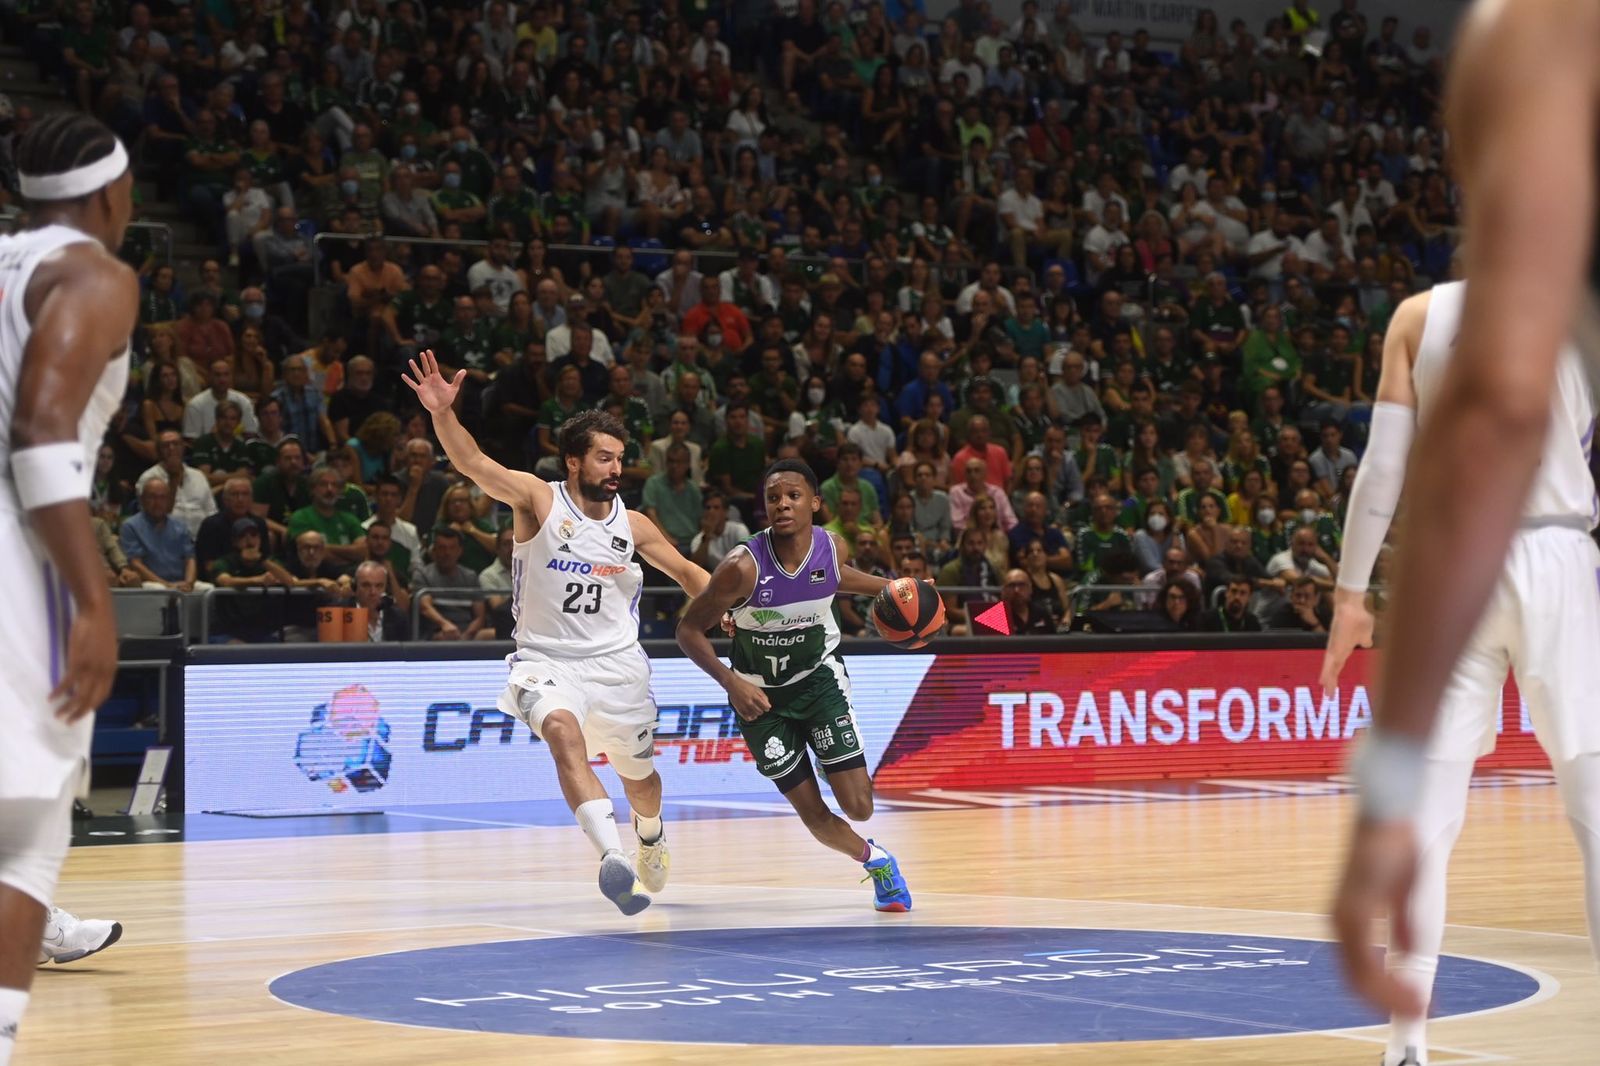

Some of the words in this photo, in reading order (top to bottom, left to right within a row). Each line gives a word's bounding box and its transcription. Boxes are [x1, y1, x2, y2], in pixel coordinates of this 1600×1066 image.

[546, 558, 626, 577] AUTOHERO
[562, 582, 603, 615] 23
[752, 634, 806, 647] málaga
[549, 989, 835, 1014] SOUTH
[849, 957, 1310, 993] RESIDENCES
